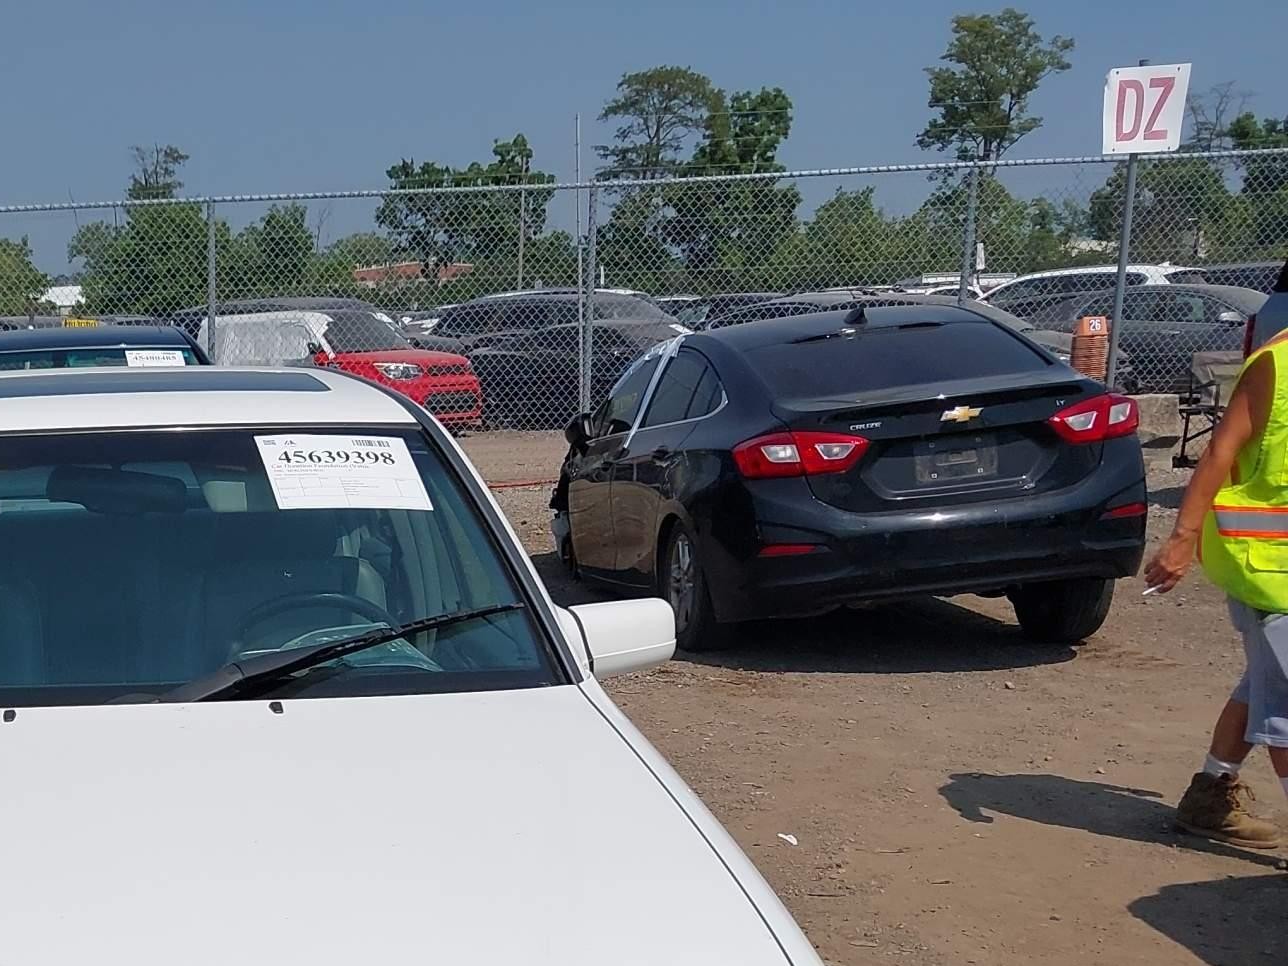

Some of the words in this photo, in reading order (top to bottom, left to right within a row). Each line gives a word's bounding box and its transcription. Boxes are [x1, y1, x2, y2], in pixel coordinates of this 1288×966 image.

[1115, 76, 1176, 142] DZ
[1089, 319, 1101, 331] 26
[849, 421, 882, 432] CRUZE
[278, 450, 396, 465] 45639398
